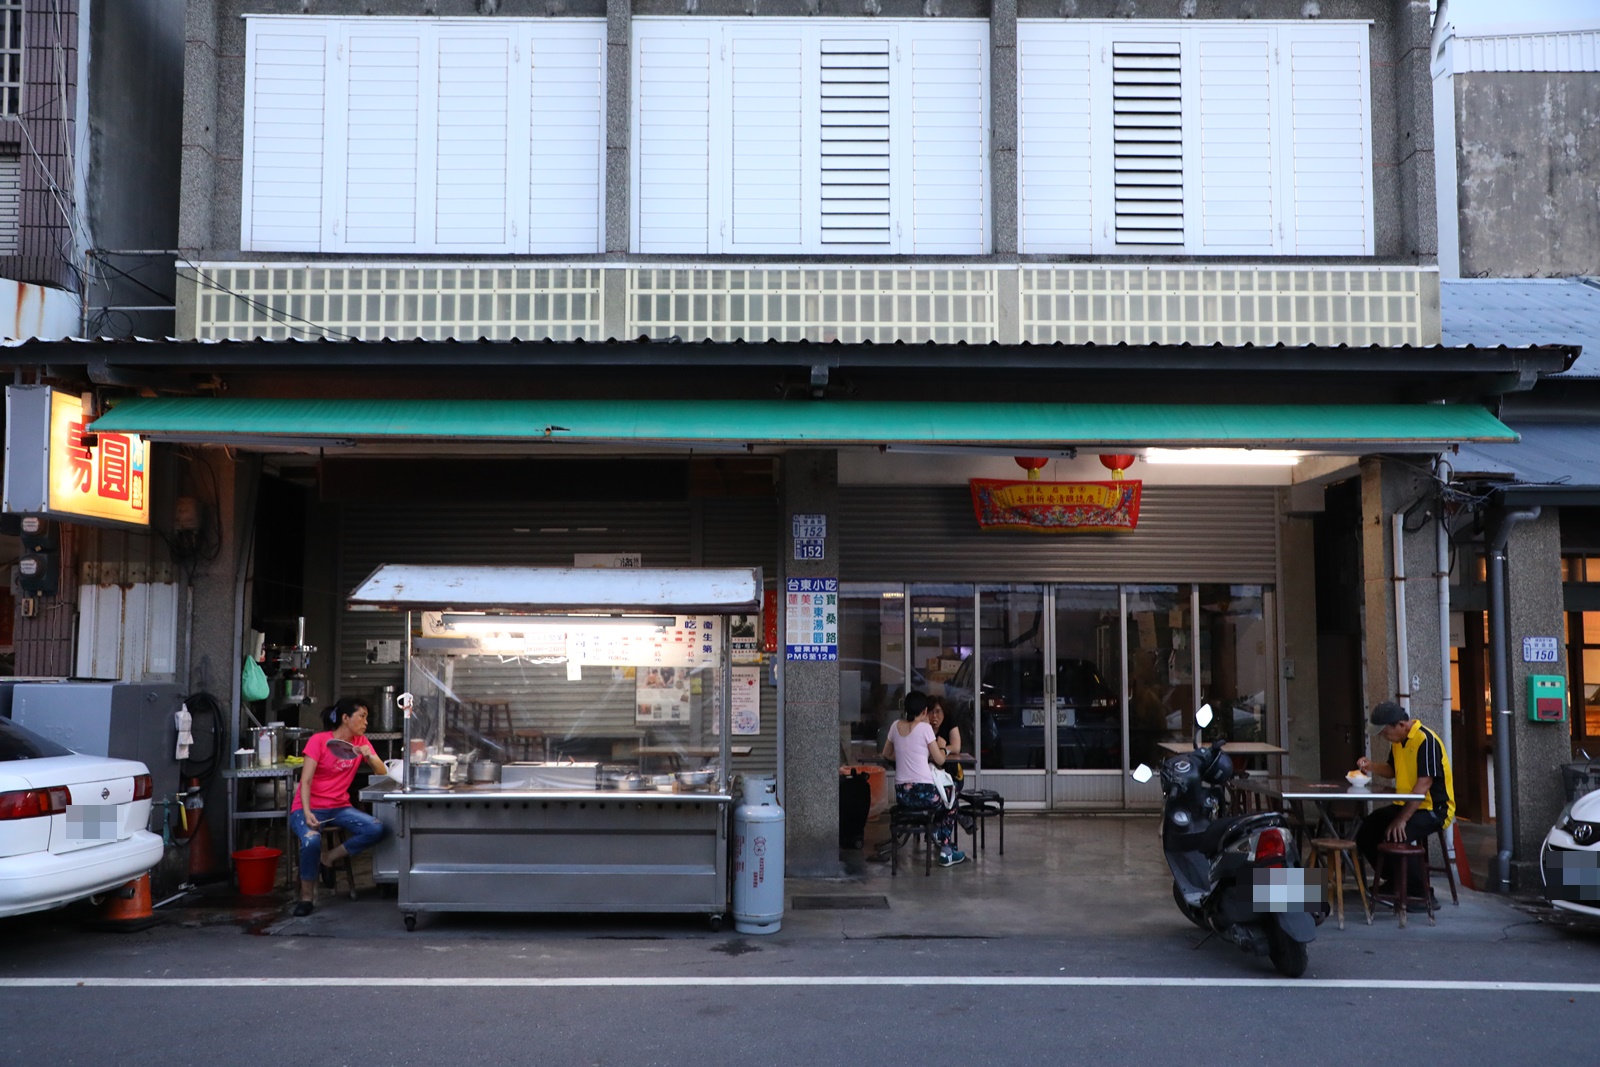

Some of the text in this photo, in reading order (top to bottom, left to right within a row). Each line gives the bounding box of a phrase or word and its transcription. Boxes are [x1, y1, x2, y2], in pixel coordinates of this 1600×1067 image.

[803, 526, 823, 537] 152
[802, 545, 822, 558] 152
[788, 579, 837, 592] 台東小吃
[813, 593, 824, 644] 台東湯圓
[825, 593, 837, 644] 寶桑路
[702, 620, 713, 663] 衛生第一
[794, 645, 829, 653] 營業時間
[1535, 650, 1554, 660] 150
